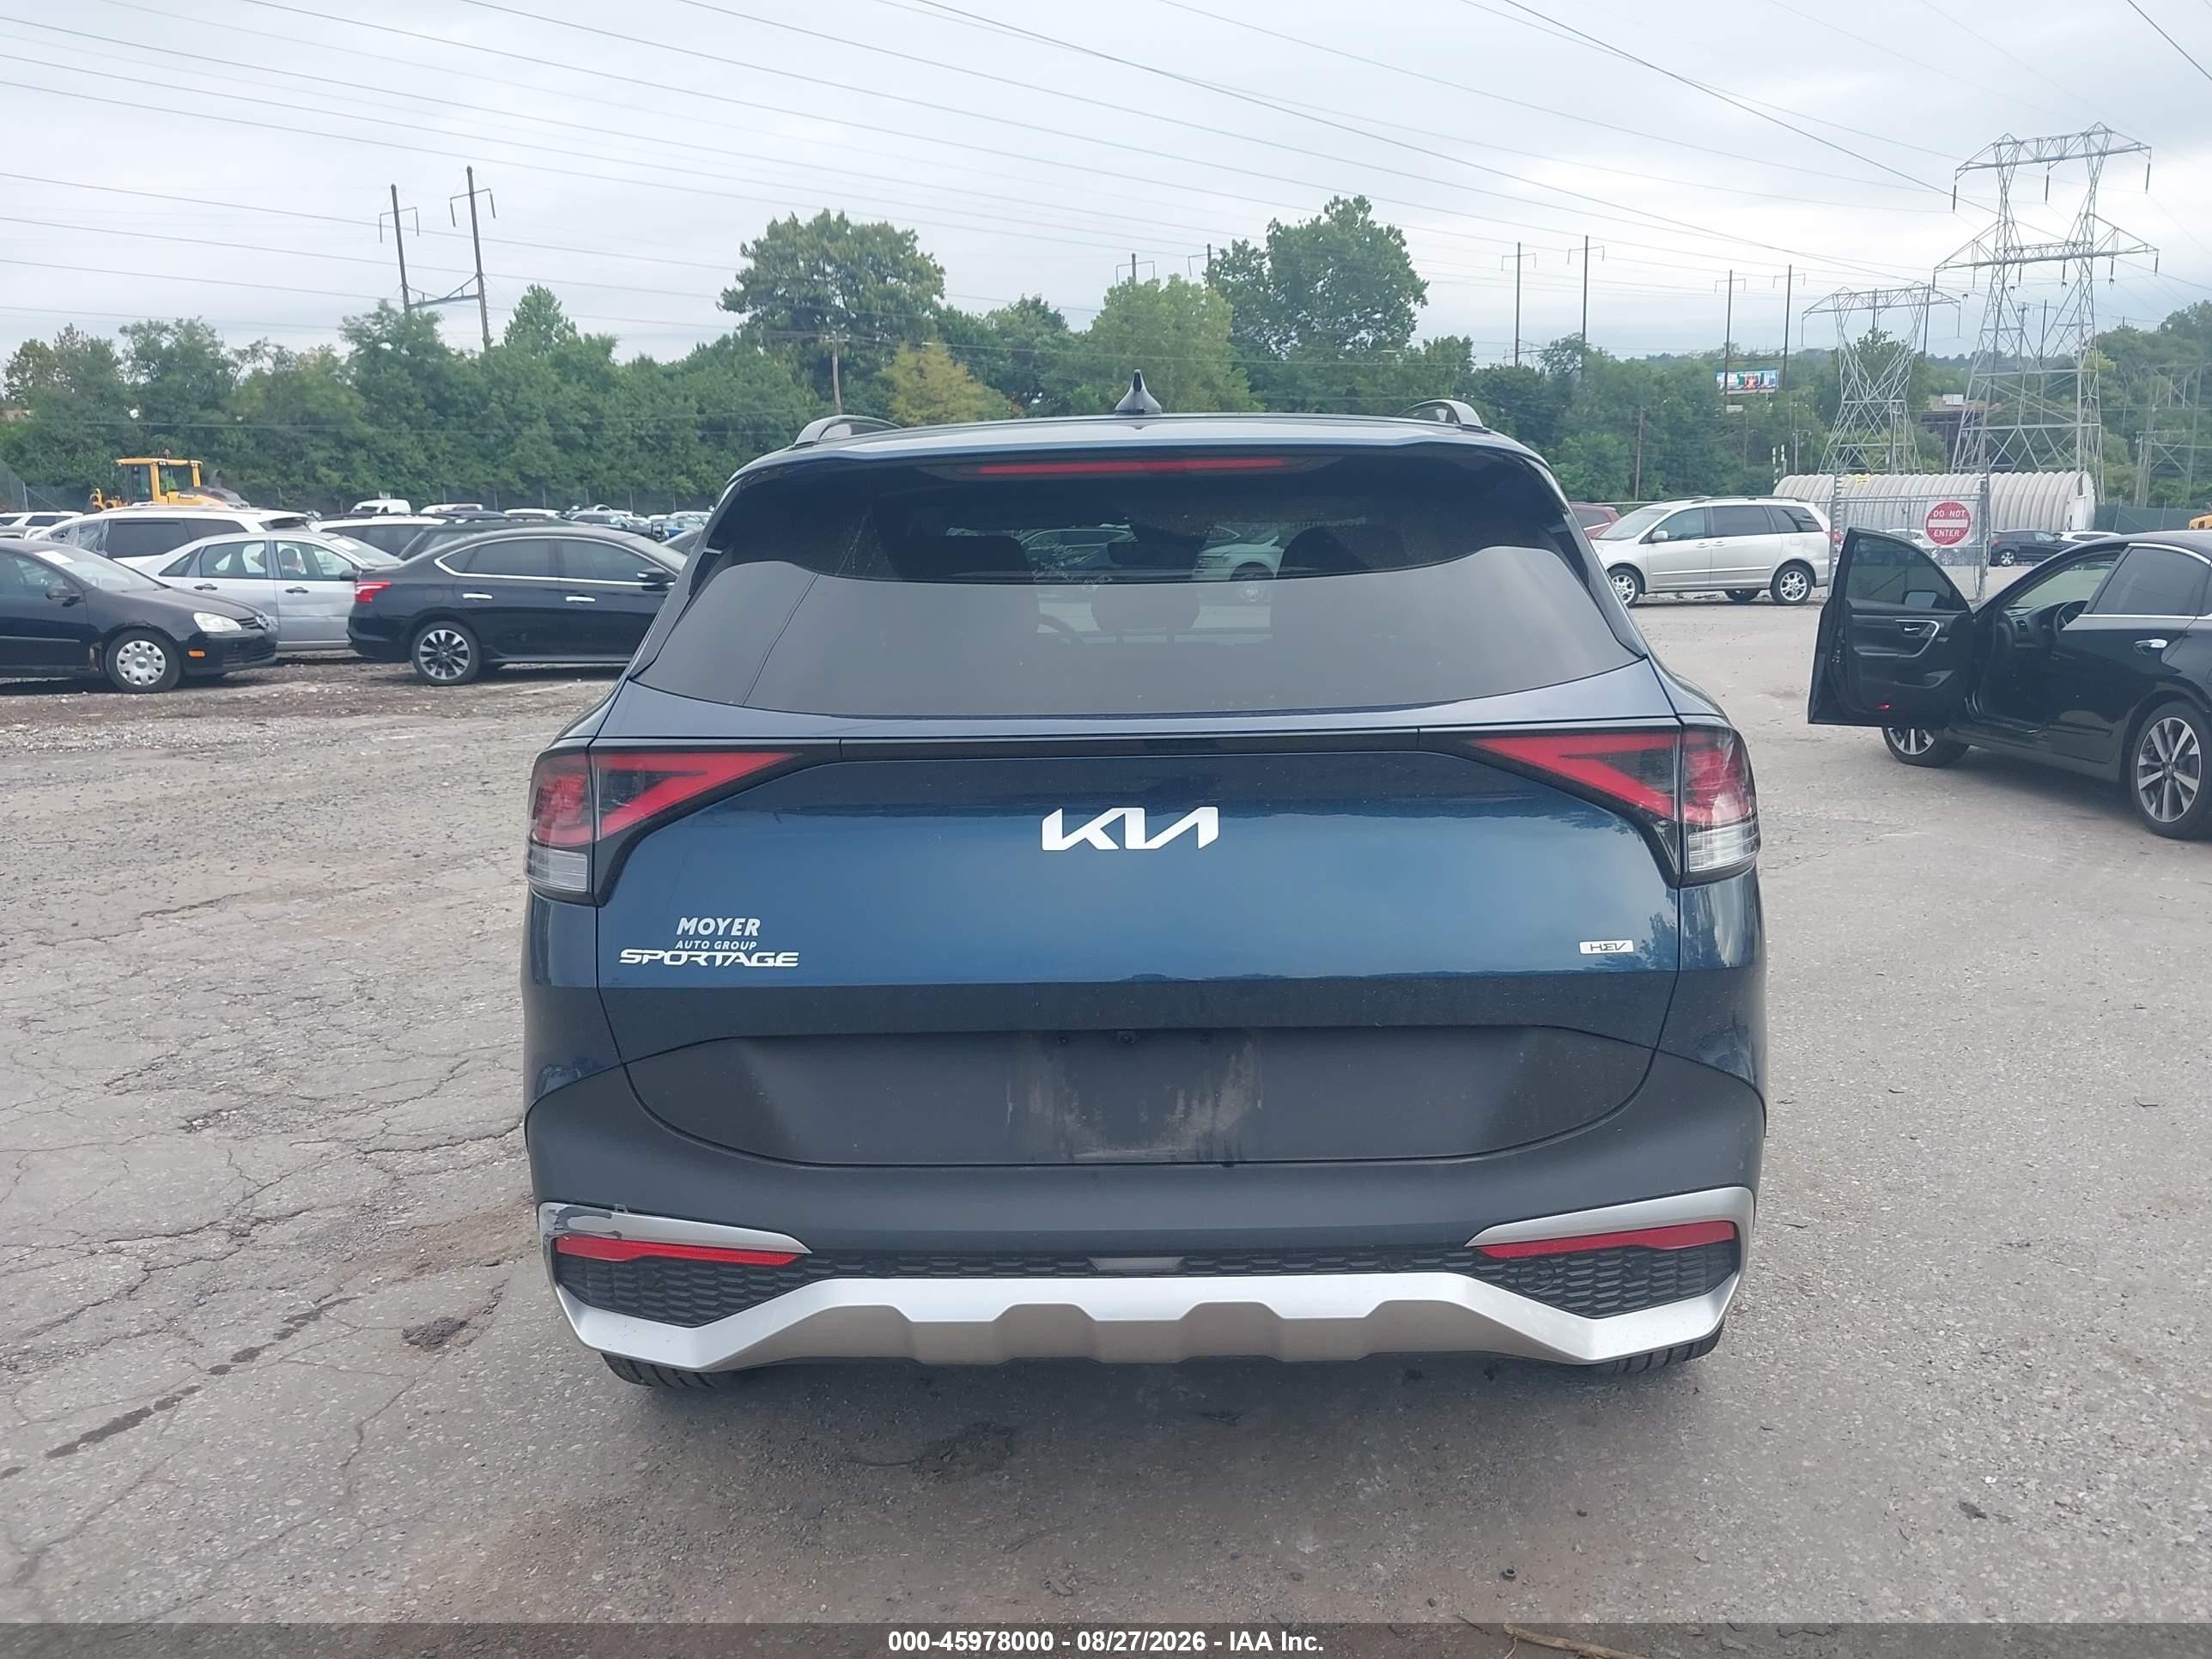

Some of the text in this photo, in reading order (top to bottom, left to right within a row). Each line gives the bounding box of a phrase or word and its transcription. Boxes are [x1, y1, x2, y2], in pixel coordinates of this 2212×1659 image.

[1041, 806, 1219, 851] KIA
[676, 917, 761, 937] MOYER
[675, 940, 757, 951] AUTO GROUP
[1589, 943, 1626, 951] HEV
[619, 949, 799, 967] SPORTAGE
